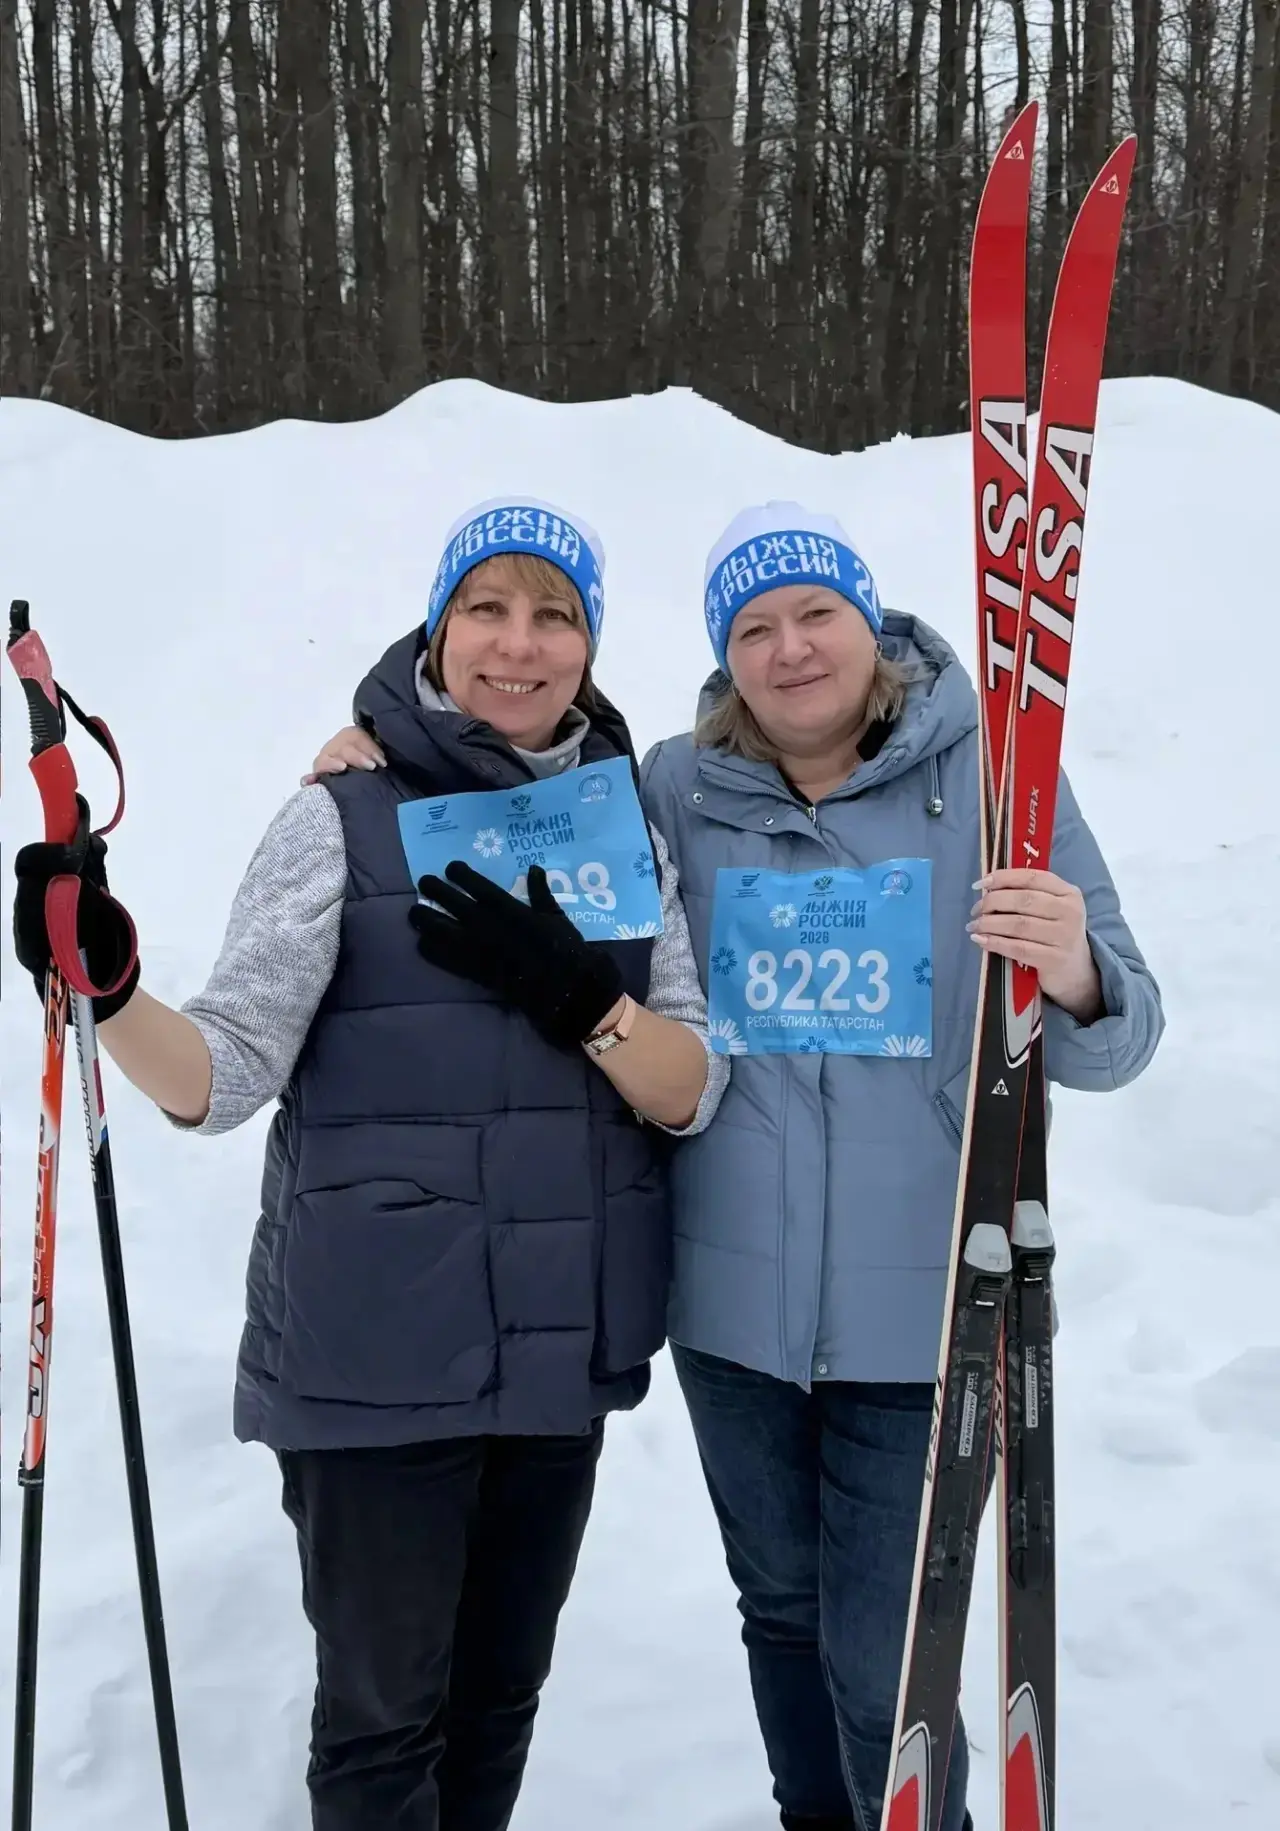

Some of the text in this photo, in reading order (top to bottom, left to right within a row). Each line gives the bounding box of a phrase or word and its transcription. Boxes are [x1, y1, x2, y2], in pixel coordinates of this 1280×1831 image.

[451, 508, 581, 550] ЛЫЖНЯ
[452, 524, 581, 573] РОССИИ
[981, 398, 1028, 691] TISA
[720, 534, 838, 590] ЛЫЖНЯ
[720, 552, 841, 608] РОССИИ
[1018, 423, 1094, 713] TISA
[506, 811, 573, 839] ЛЫЖНЯ
[508, 827, 575, 853] РОССИИ
[566, 911, 616, 925] АРСТАН
[798, 913, 867, 929] РОССИИ
[800, 899, 868, 914] ЛЫЖНЯ
[745, 948, 891, 1014] 8223
[745, 1015, 885, 1032] РЕСПУБЛИКА ТАТАРСТАН
